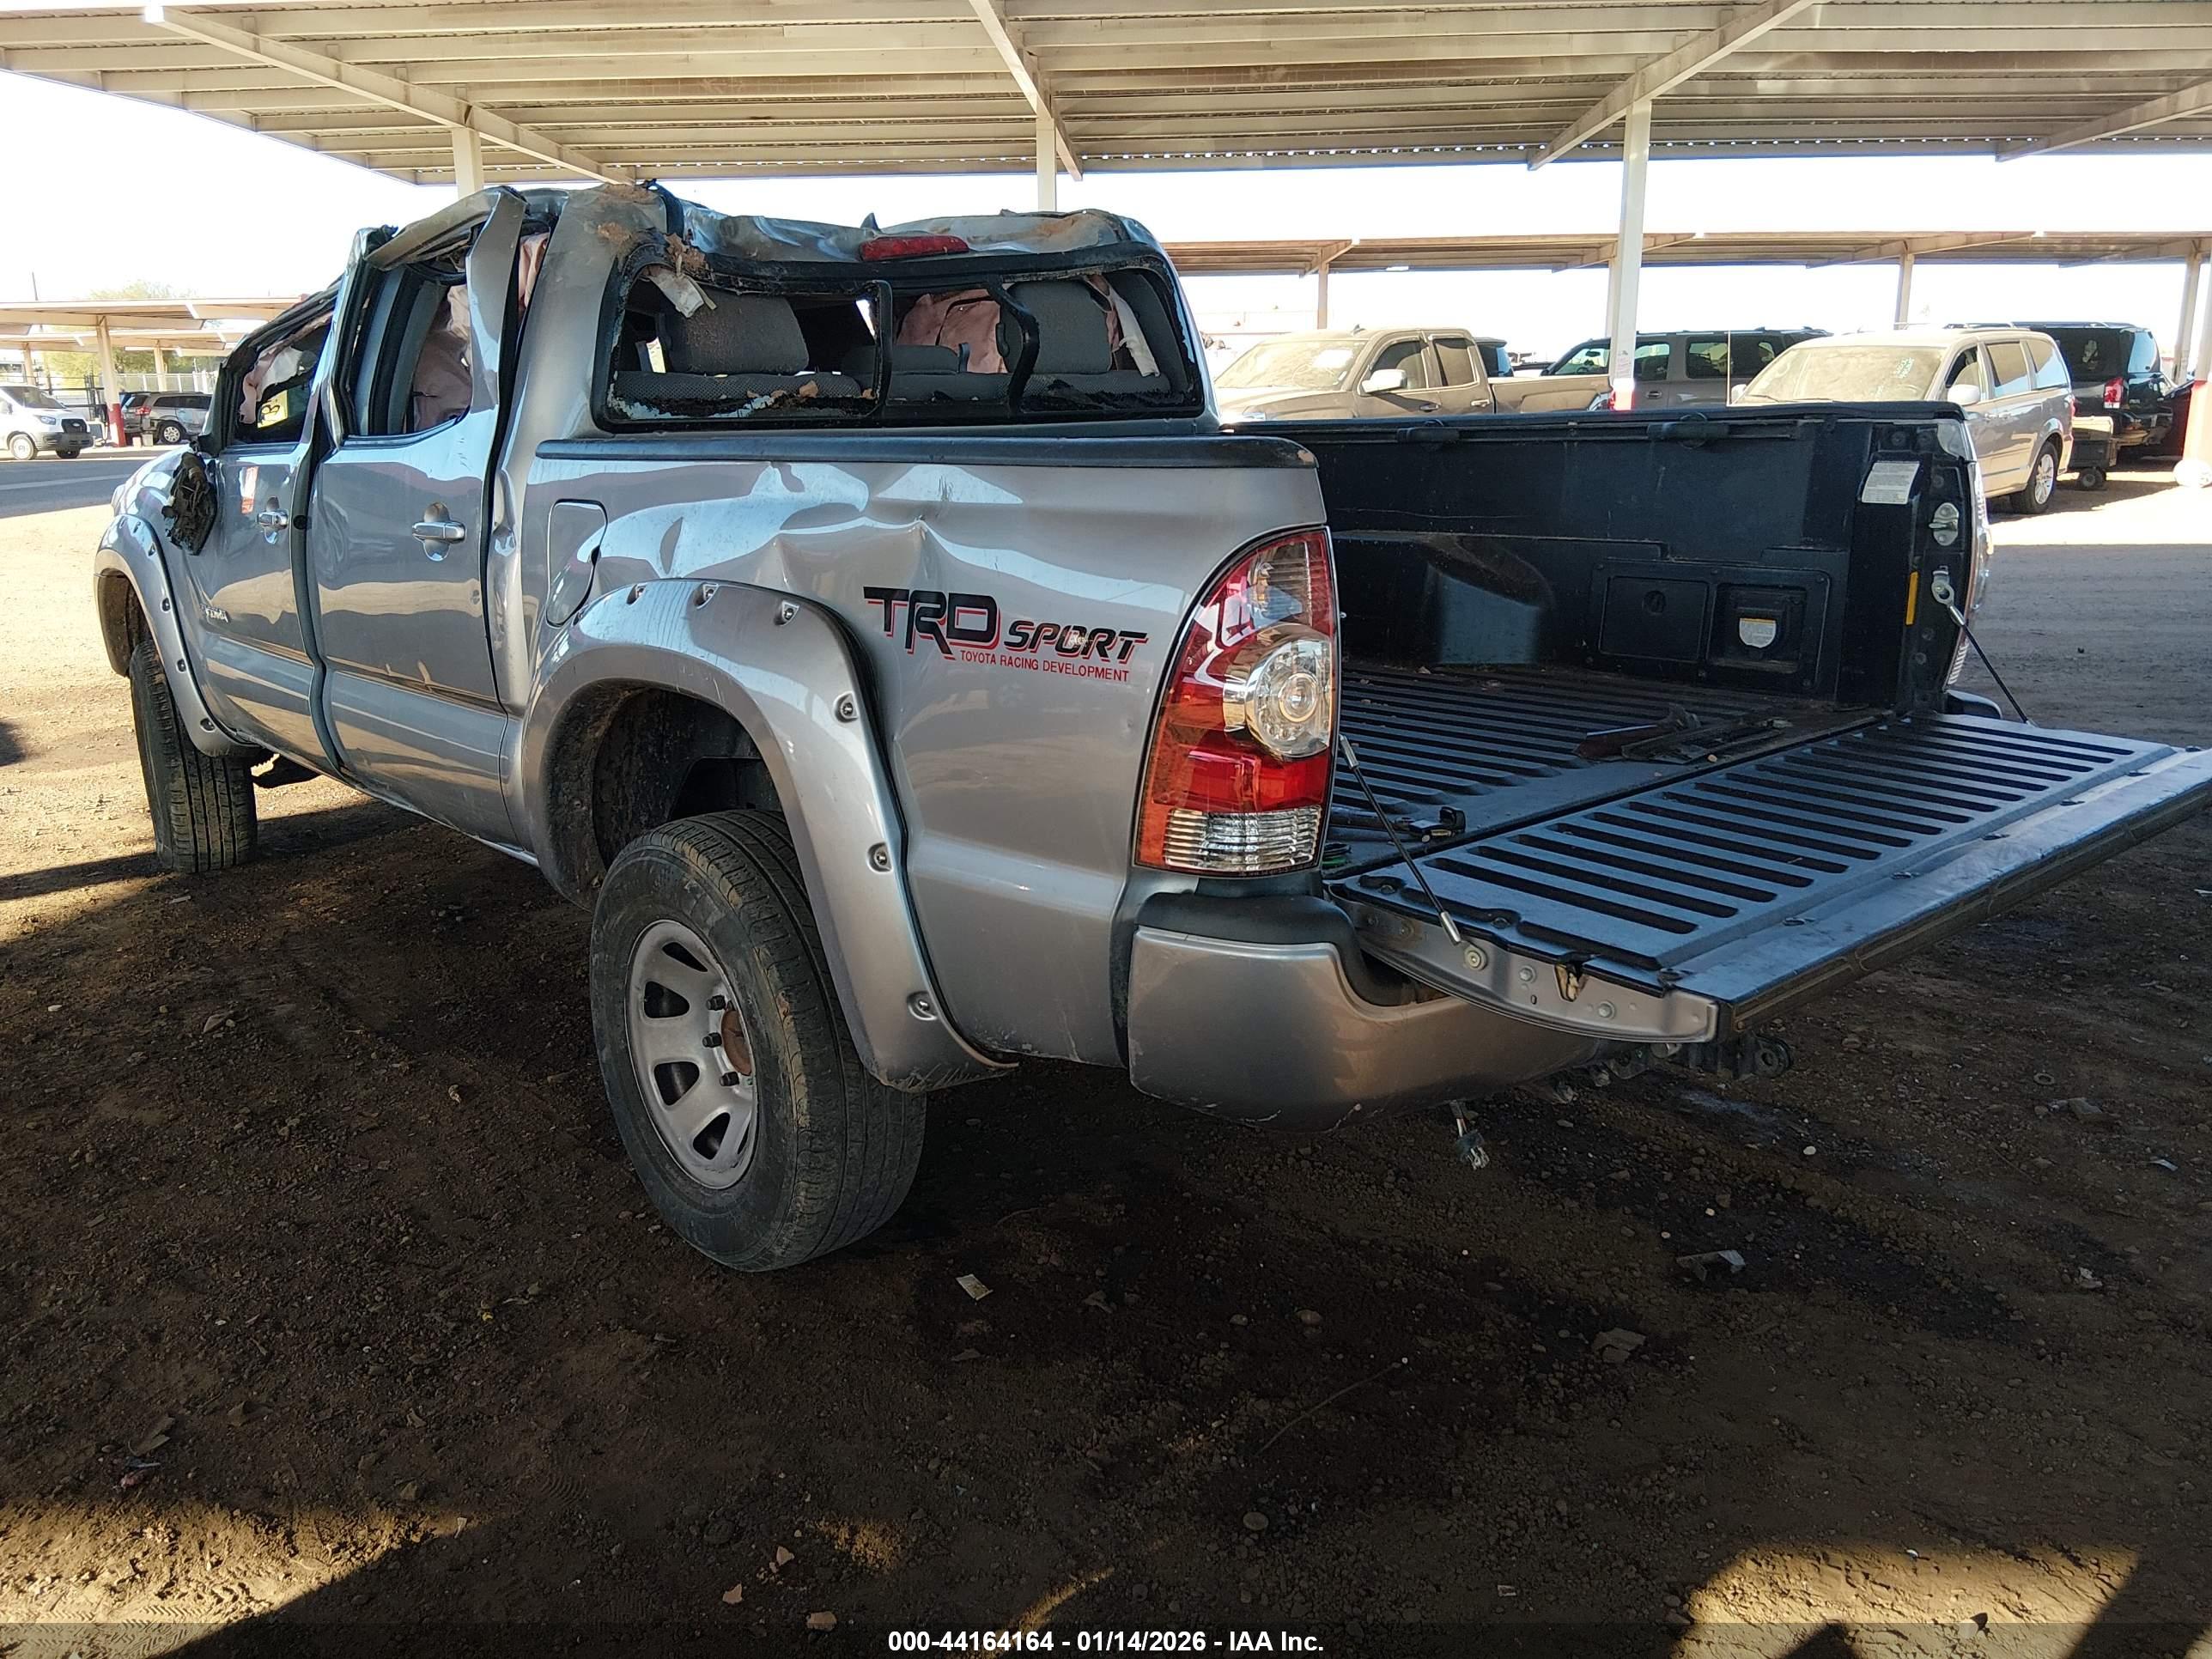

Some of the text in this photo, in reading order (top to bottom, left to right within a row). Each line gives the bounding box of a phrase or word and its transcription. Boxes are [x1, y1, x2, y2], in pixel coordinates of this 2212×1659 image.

[863, 586, 1149, 665] TRD SPORT
[960, 650, 1129, 683] TOYOTA RACING DEVELOPMENT
